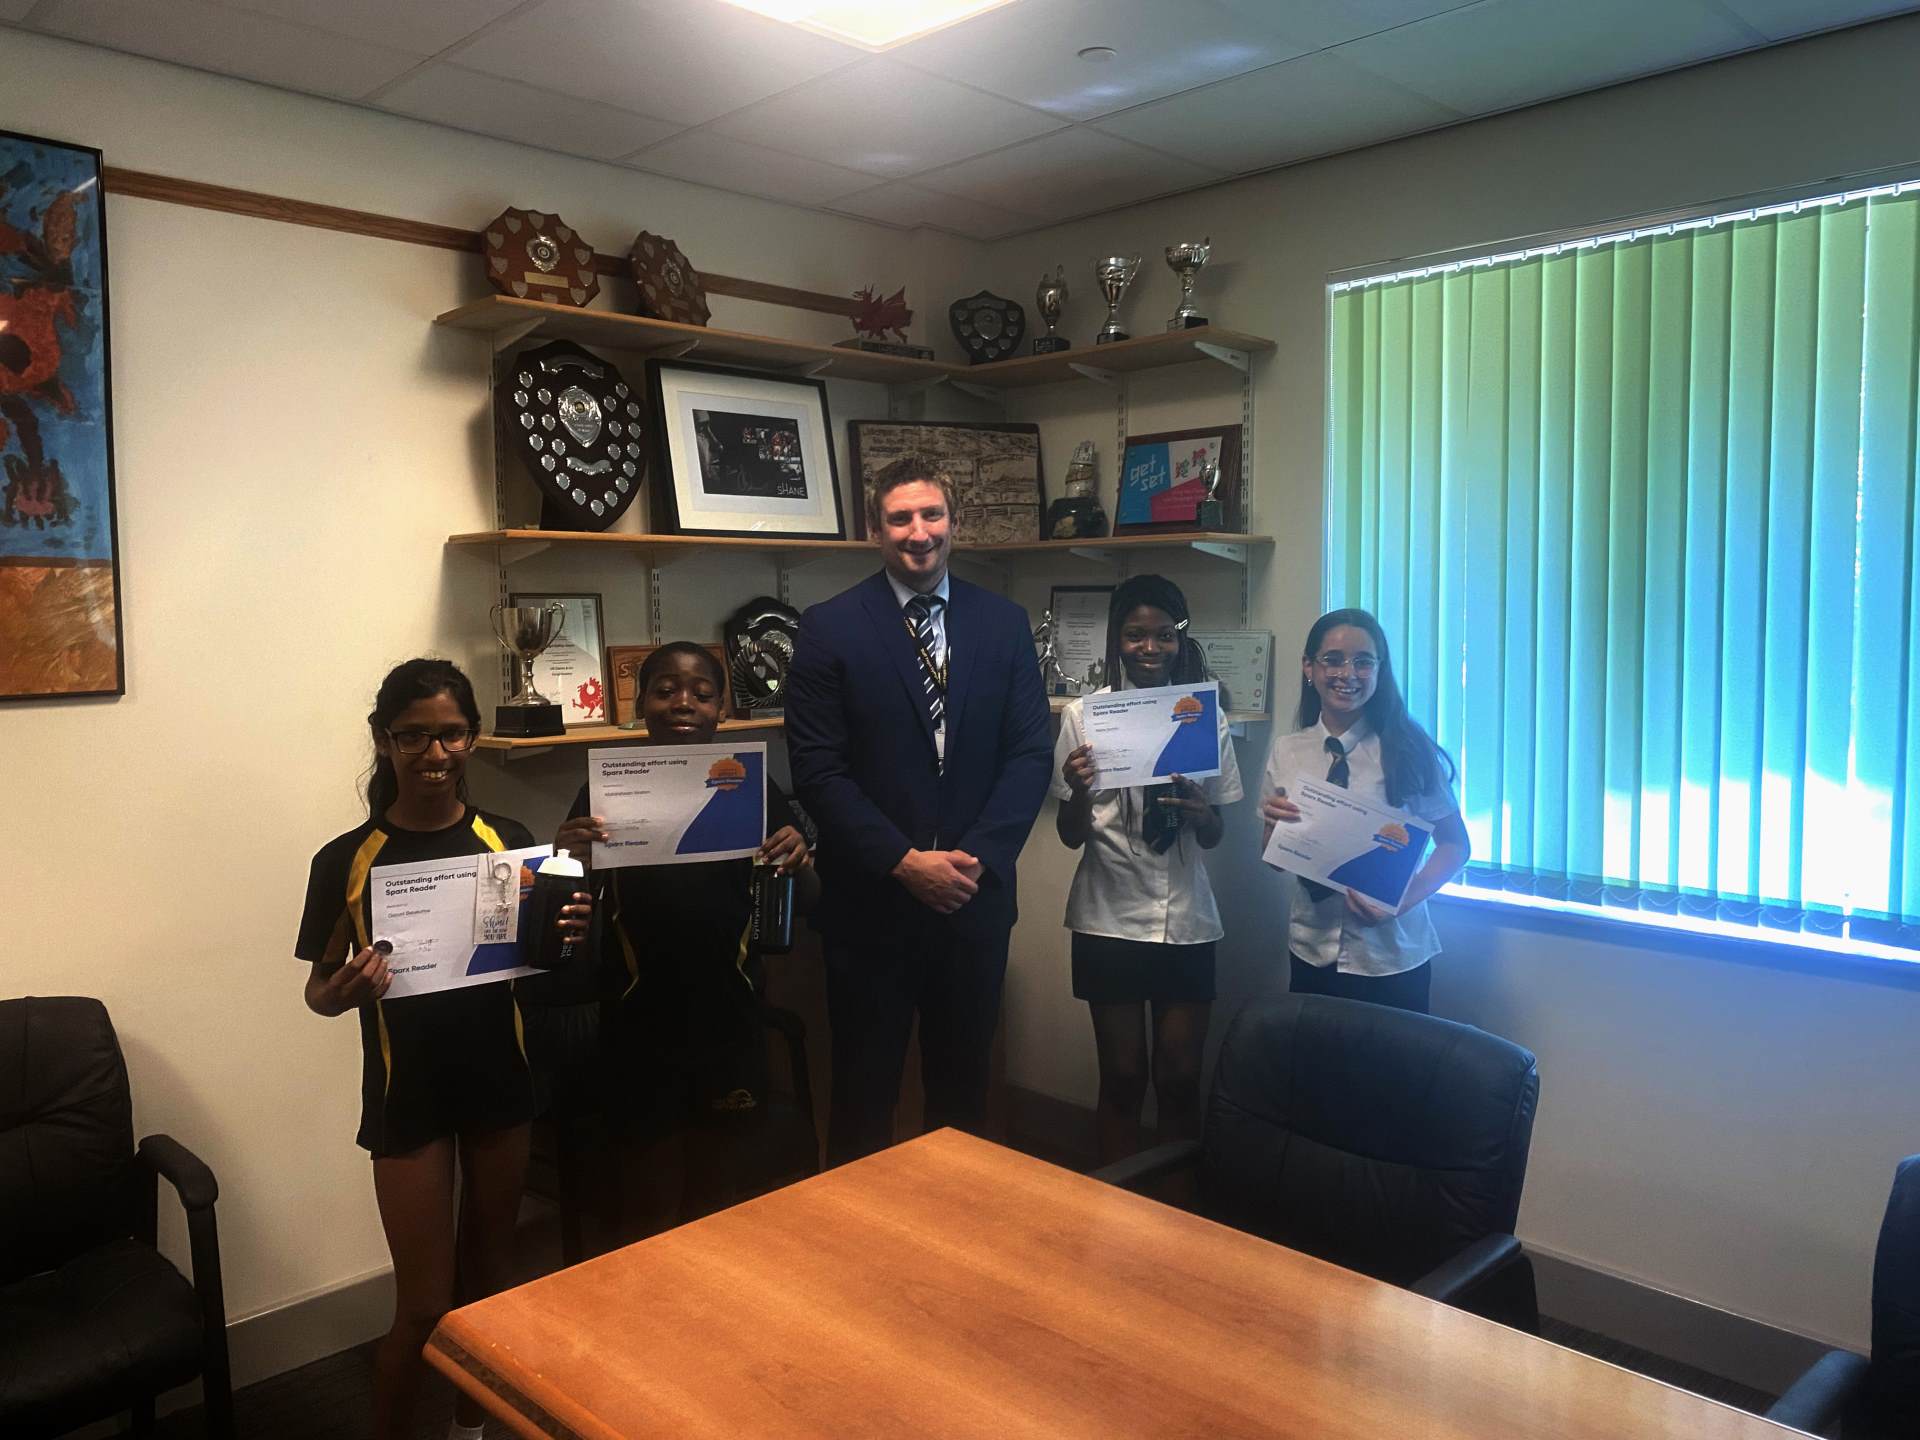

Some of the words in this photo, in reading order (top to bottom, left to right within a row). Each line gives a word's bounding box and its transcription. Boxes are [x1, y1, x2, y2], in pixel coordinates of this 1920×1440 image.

[1130, 454, 1156, 487] get
[1140, 466, 1166, 491] set
[777, 482, 806, 497] SHANE
[1093, 702, 1125, 711] Outstanding
[1126, 700, 1142, 708] effort
[1109, 708, 1129, 716] Reader
[602, 761, 646, 769] Outstanding
[602, 769, 623, 777] Sparx
[625, 839, 649, 847] Reader
[385, 877, 432, 887] Outstanding
[434, 873, 456, 882] effort
[457, 871, 477, 879] using
[385, 887, 408, 896] Sparx
[409, 884, 437, 893] Reader
[411, 963, 437, 973] Reader
